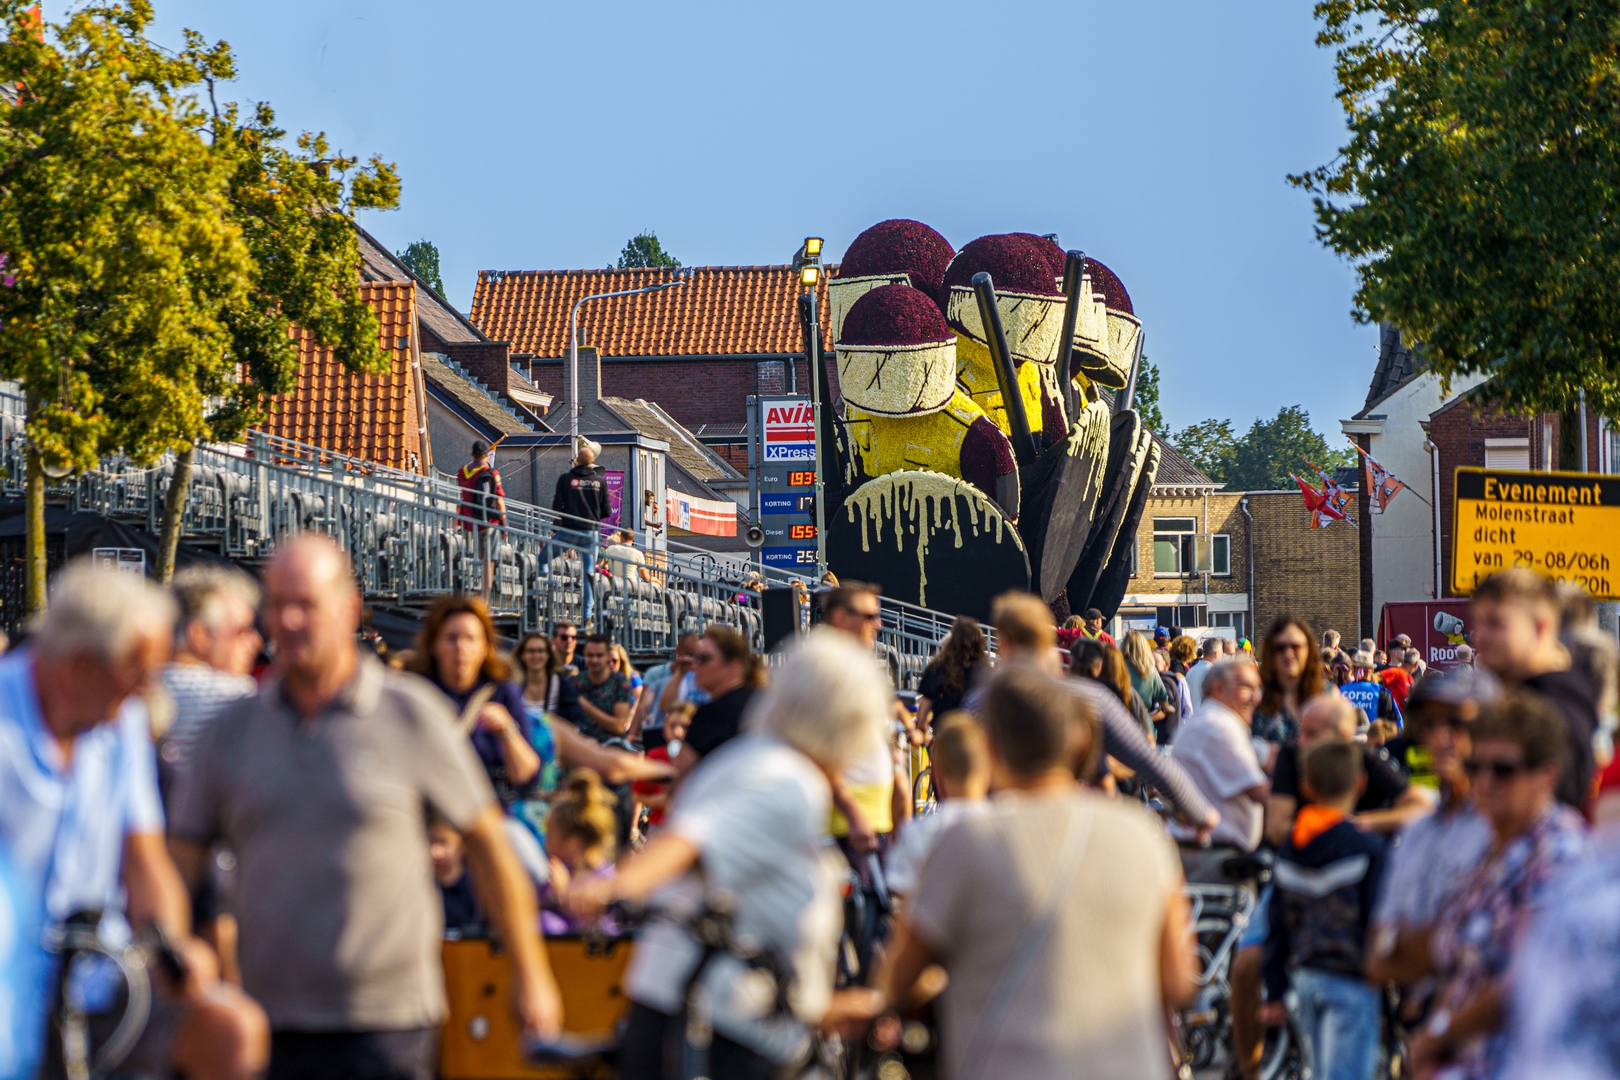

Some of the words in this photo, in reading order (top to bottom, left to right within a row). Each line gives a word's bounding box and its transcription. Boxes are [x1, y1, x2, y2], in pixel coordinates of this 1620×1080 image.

[769, 447, 817, 459] XPress
[764, 475, 779, 483] Euro
[1484, 476, 1602, 506] Evenement
[1475, 502, 1575, 524] Molenstraat
[1474, 525, 1516, 544] dicht
[1474, 551, 1503, 567] van
[1513, 550, 1610, 571] 29-08/06h
[1342, 690, 1374, 700] corso
